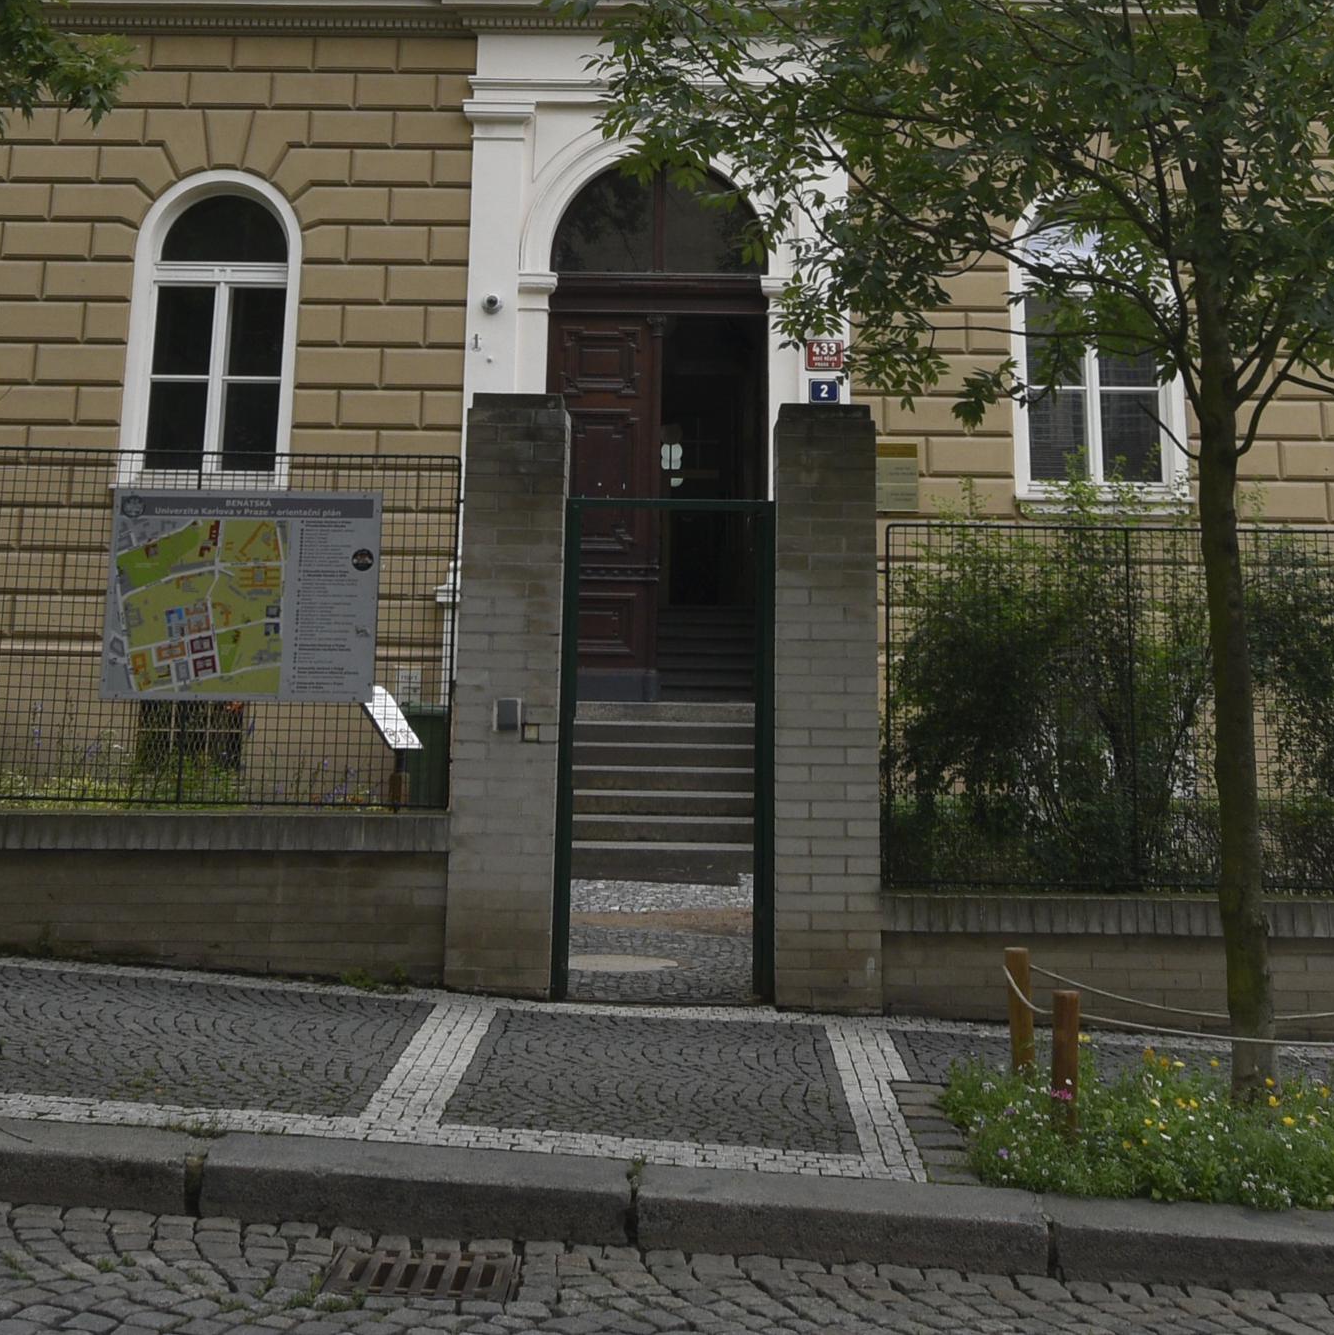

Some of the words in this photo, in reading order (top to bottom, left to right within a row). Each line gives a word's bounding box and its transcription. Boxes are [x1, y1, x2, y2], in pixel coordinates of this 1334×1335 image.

[812, 343, 837, 355] 433
[820, 384, 829, 397] 2
[154, 507, 199, 515] Univerzita
[201, 507, 235, 515] Karlova
